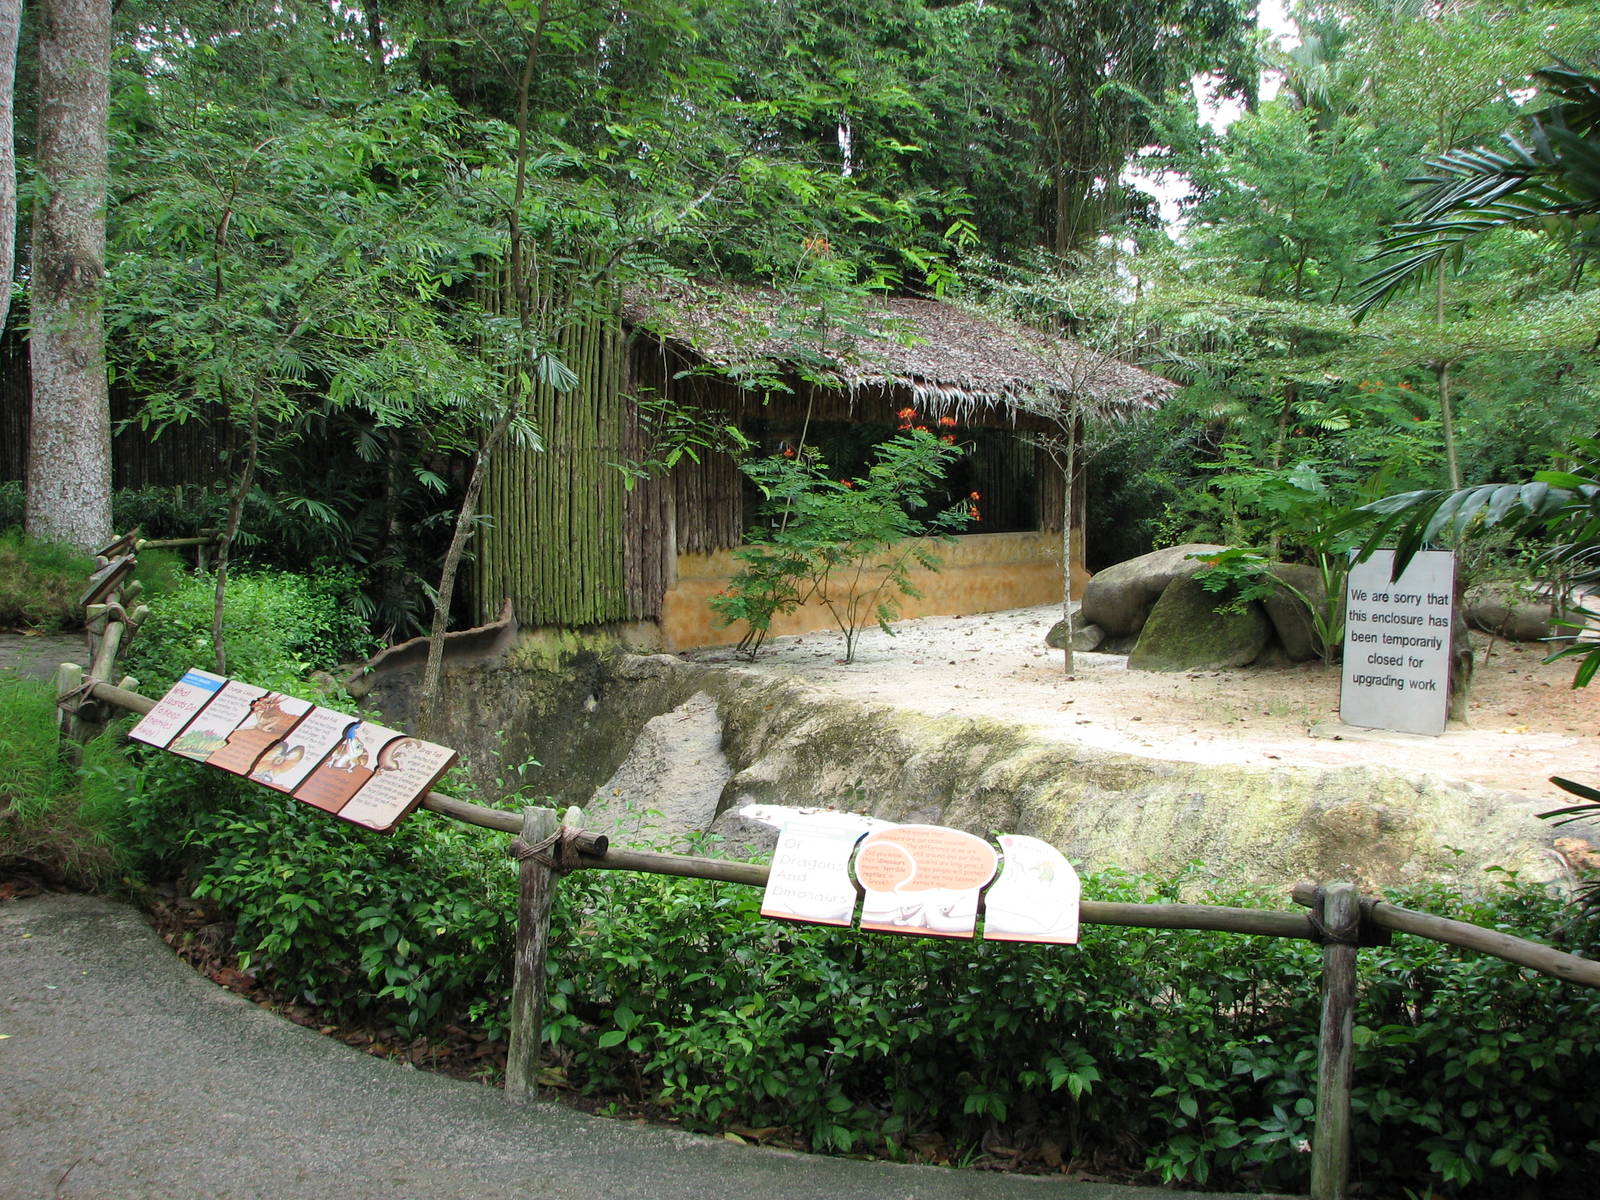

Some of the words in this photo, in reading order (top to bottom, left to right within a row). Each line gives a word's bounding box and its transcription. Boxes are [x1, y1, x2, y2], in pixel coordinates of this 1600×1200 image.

[1351, 589, 1367, 601] We
[1371, 592, 1389, 603] are
[1394, 593, 1422, 606] sorry
[1427, 592, 1449, 606] that
[1349, 610, 1367, 622] this
[1371, 612, 1423, 626] enclosure
[1428, 614, 1449, 627] has
[1351, 630, 1377, 643] been
[1382, 632, 1443, 651] temporarily
[1367, 653, 1403, 666] closed
[1408, 656, 1424, 668] for
[1352, 674, 1404, 691] upgrading
[1409, 679, 1436, 691] work
[779, 854, 844, 872] Dragons
[777, 869, 807, 881] And
